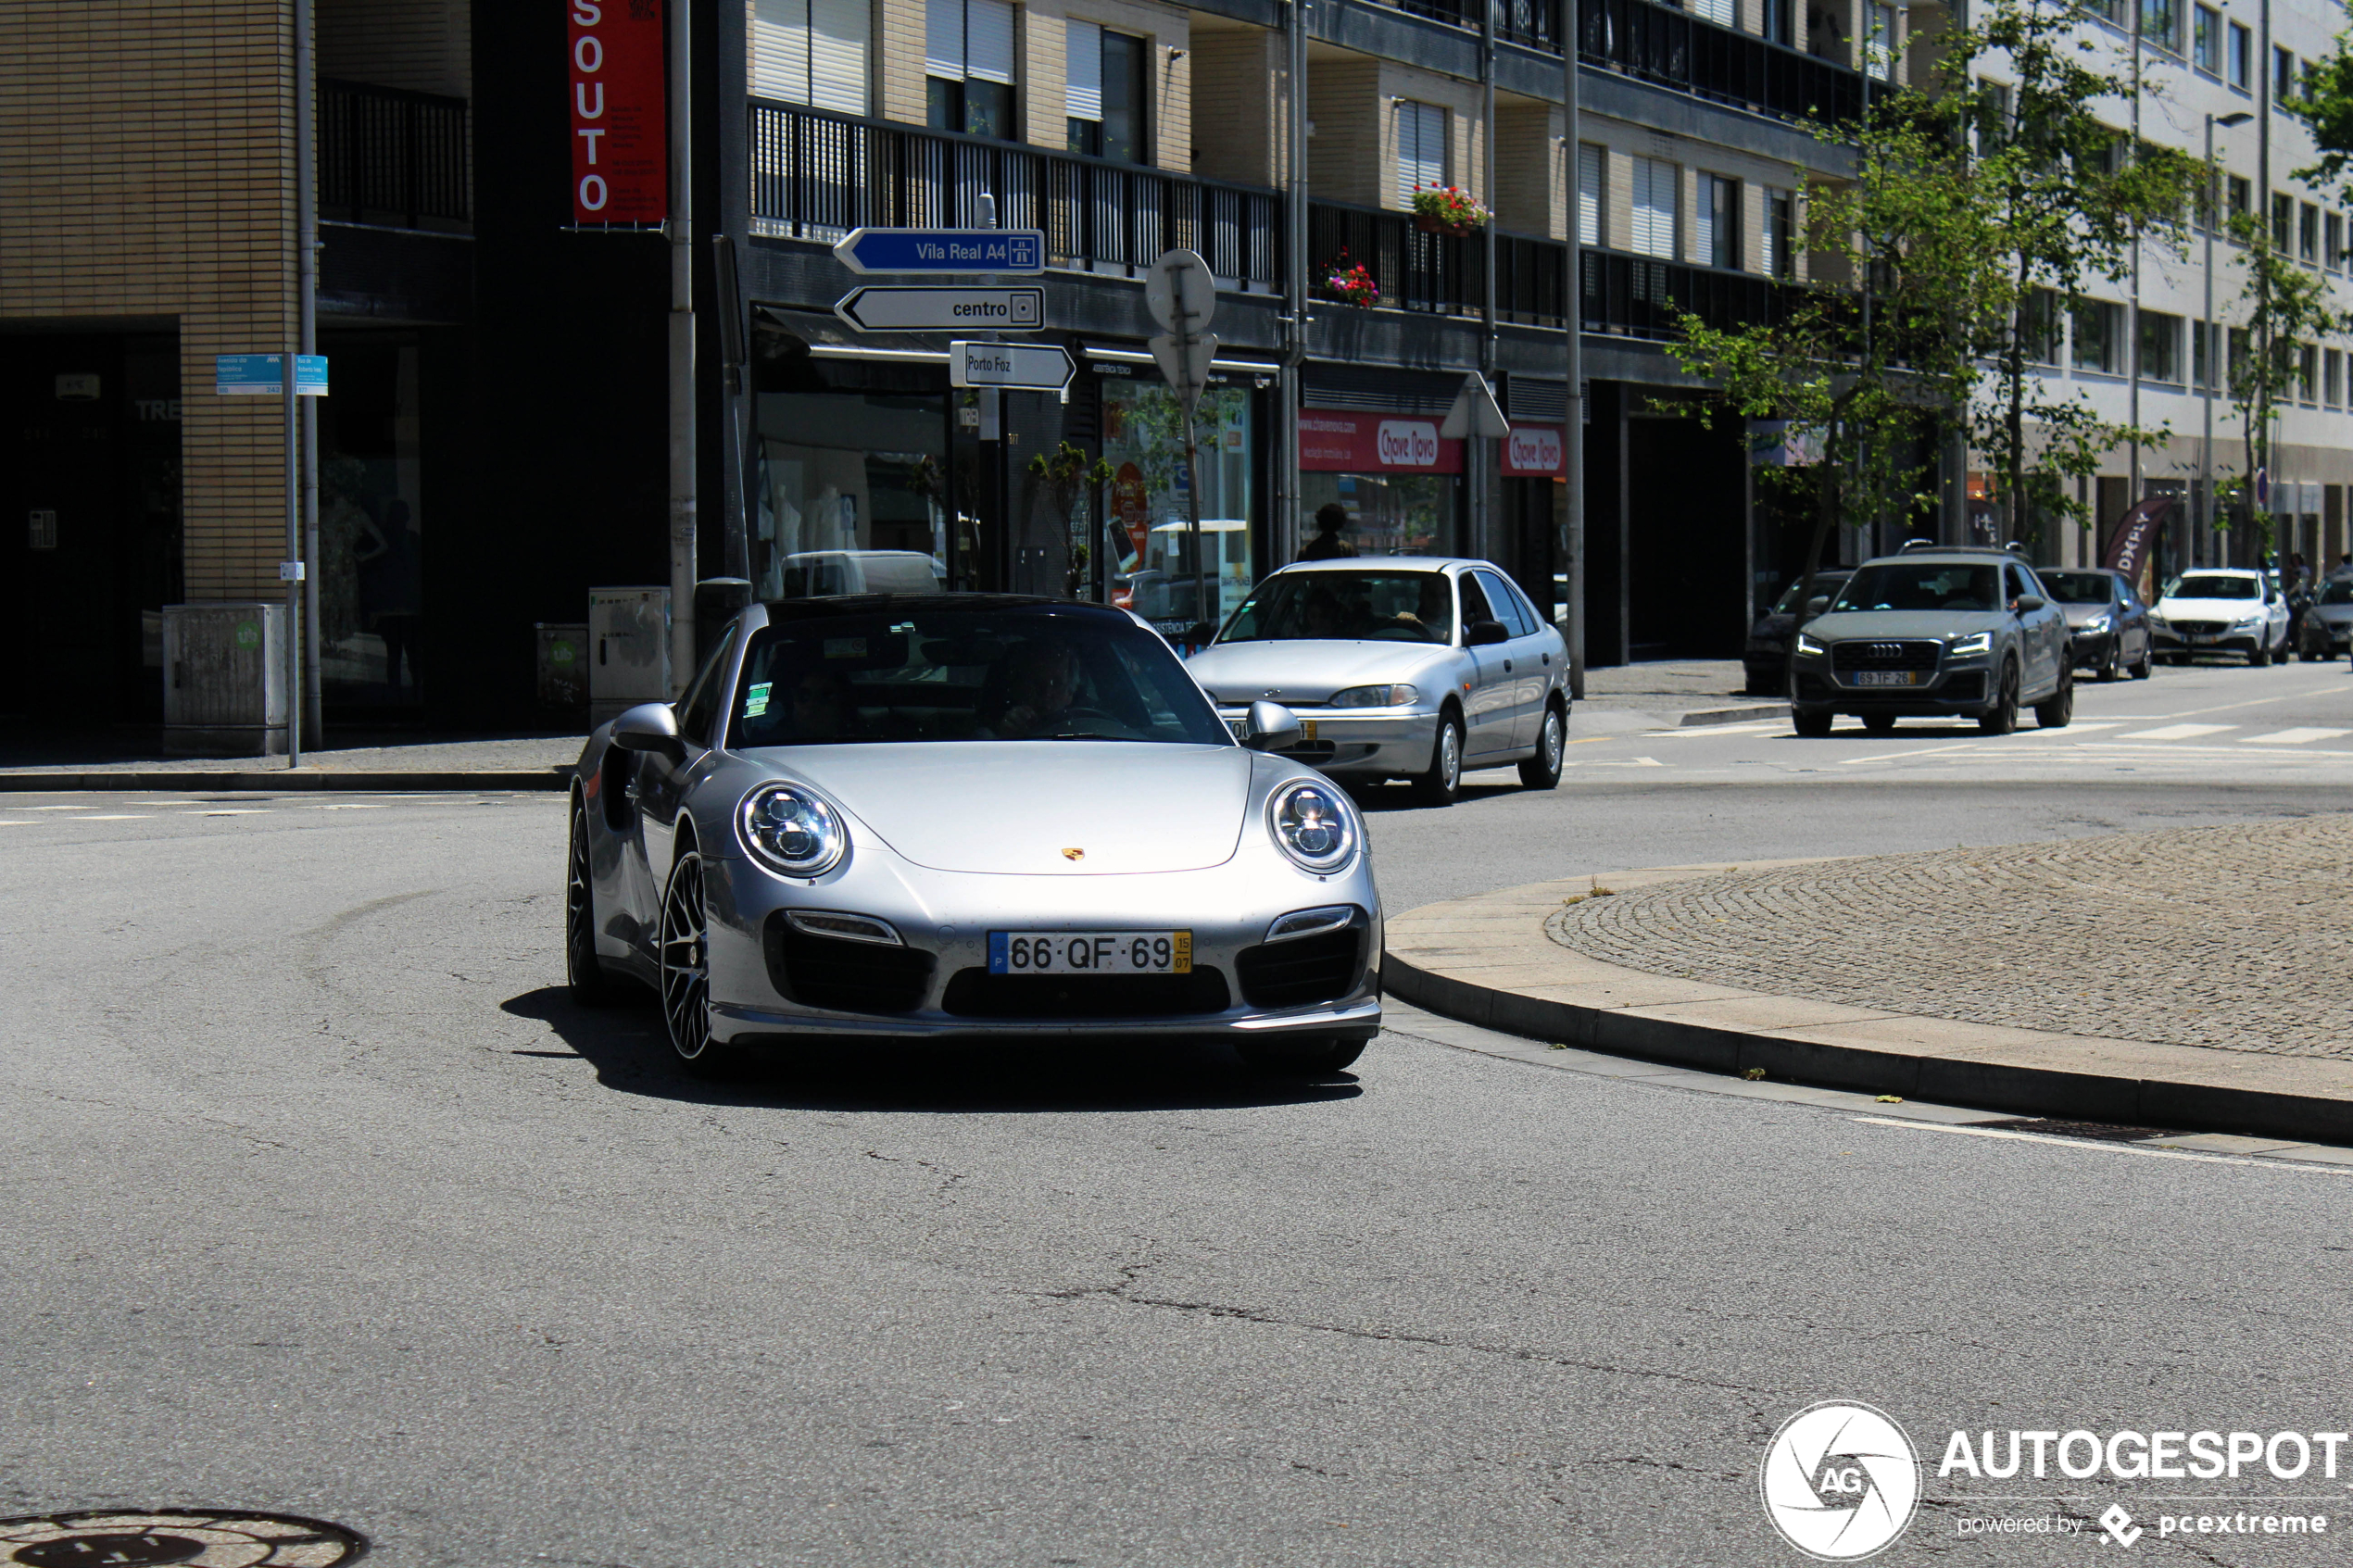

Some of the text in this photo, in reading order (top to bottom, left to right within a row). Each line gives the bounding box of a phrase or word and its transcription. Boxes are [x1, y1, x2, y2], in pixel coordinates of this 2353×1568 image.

[915, 243, 1007, 260] Vila Real A4
[953, 301, 1007, 317] centro
[968, 355, 1011, 372] Porto Foz
[1382, 429, 1434, 465] Chave Nova
[1178, 937, 1189, 948] 15
[995, 957, 1002, 966] P
[1176, 958, 1189, 969] 07
